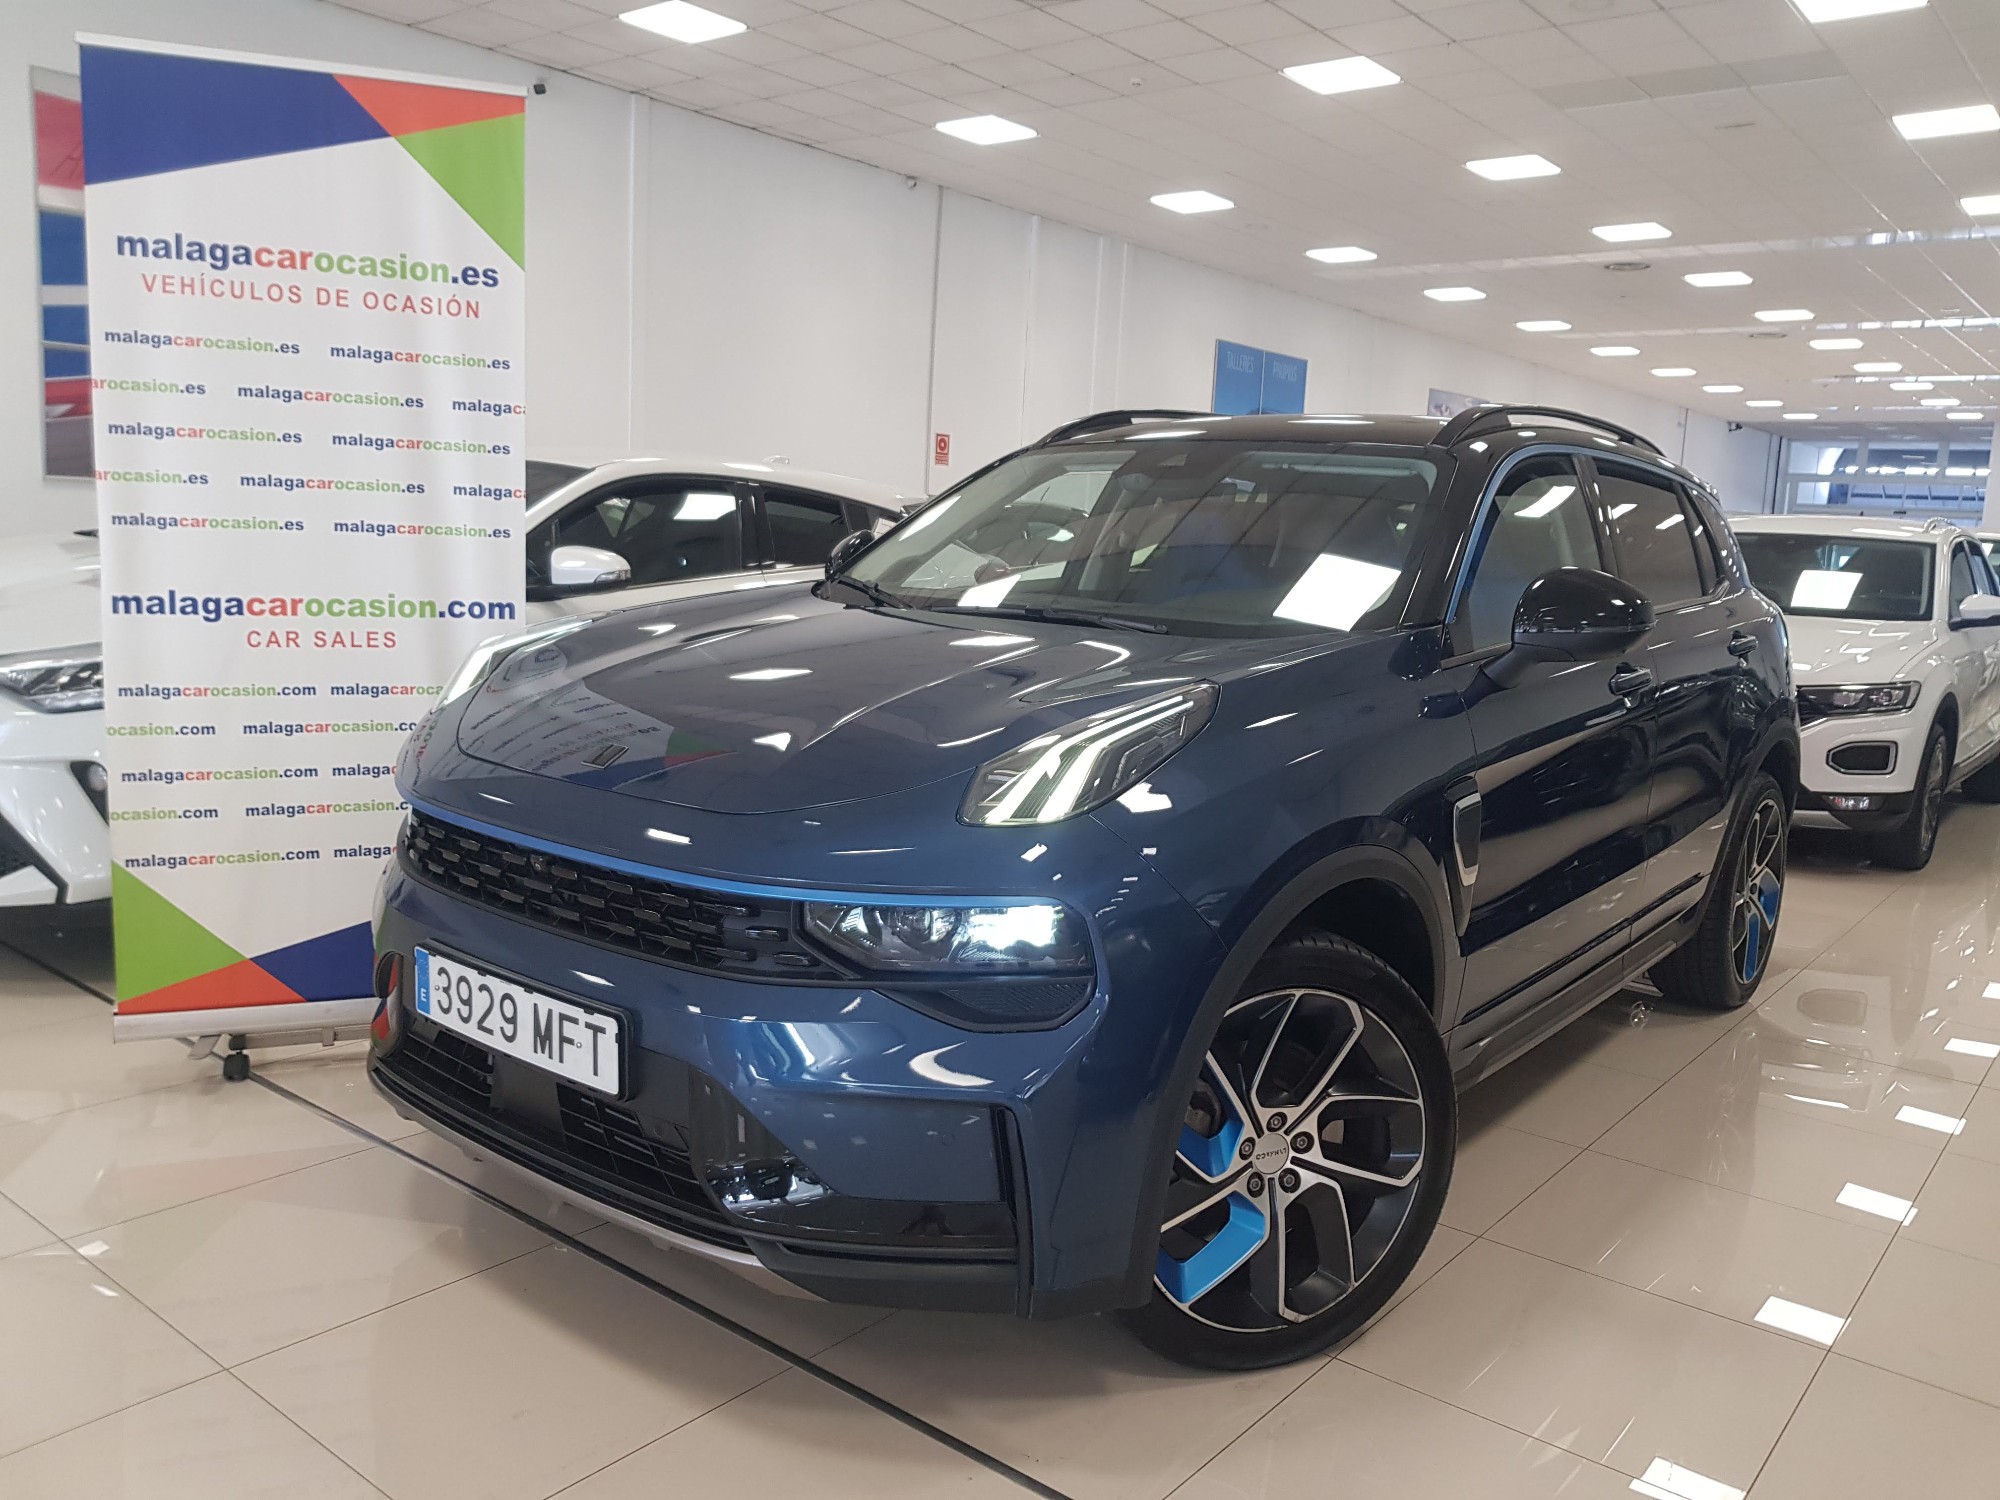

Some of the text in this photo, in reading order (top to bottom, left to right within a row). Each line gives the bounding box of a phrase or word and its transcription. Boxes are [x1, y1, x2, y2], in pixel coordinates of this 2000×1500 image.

[116, 232, 500, 288] malagacarocasion.es
[141, 273, 480, 318] VEHÍCULOS DE OCASIÓN
[104, 330, 511, 370] malagacarocasion.es malagacarocasion.es
[238, 385, 424, 407] malagacarocasion.es
[108, 422, 511, 454] malagacarocasion.es malagacarocasion.es
[240, 474, 425, 493] malagacarocasion.es
[111, 512, 511, 538] malagacarocasion.es malagacarocasion.es
[111, 589, 516, 622] malagacarocasion.com
[247, 631, 397, 648] CAR SALES
[118, 684, 317, 700] malagacarocasion.com
[121, 767, 319, 785] malagacarocasion.com
[125, 849, 321, 869] malagacarocasion.com
[420, 987, 427, 1002] E
[437, 966, 606, 1076] 3929 MFT
